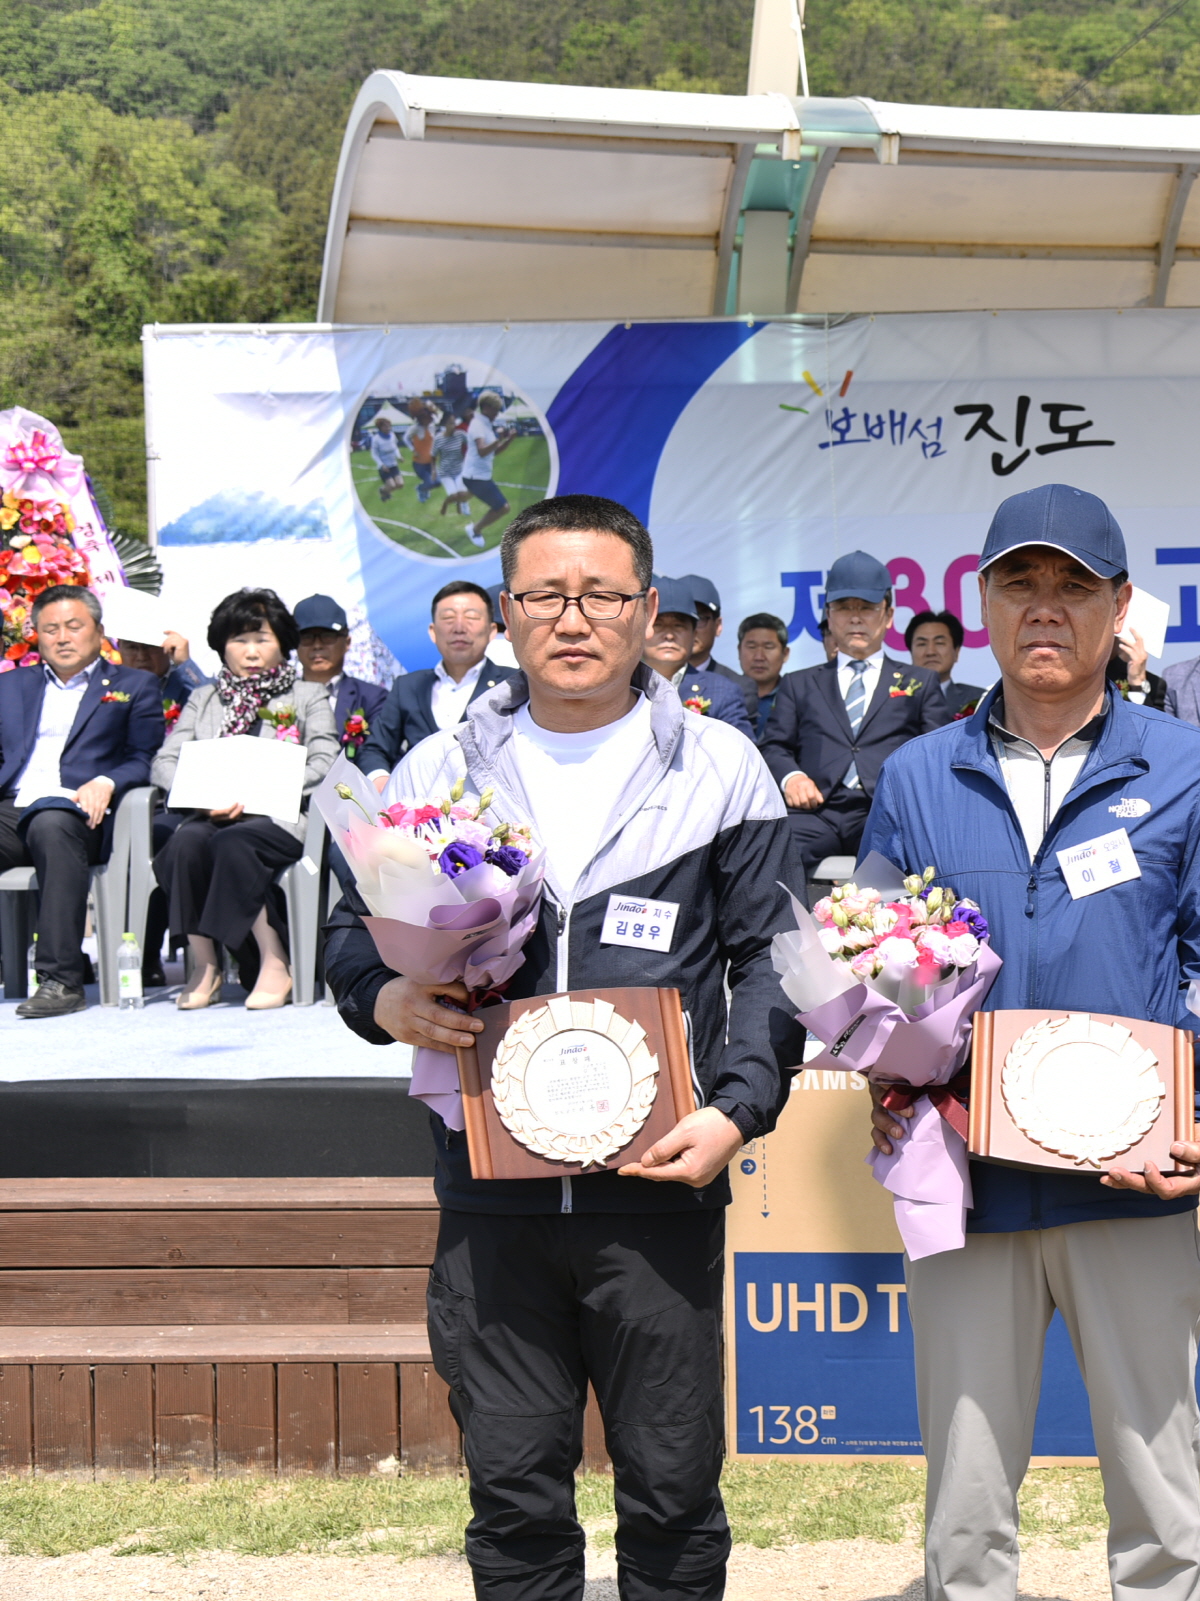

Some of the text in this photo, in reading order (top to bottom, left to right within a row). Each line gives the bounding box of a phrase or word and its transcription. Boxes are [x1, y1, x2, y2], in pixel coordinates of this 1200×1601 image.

[818, 395, 1116, 477] 보배섬 진도
[613, 901, 673, 920] Jindo 지수
[615, 920, 661, 940] 김영우
[746, 1282, 869, 1333] UHD
[748, 1405, 837, 1445] 138 cm
